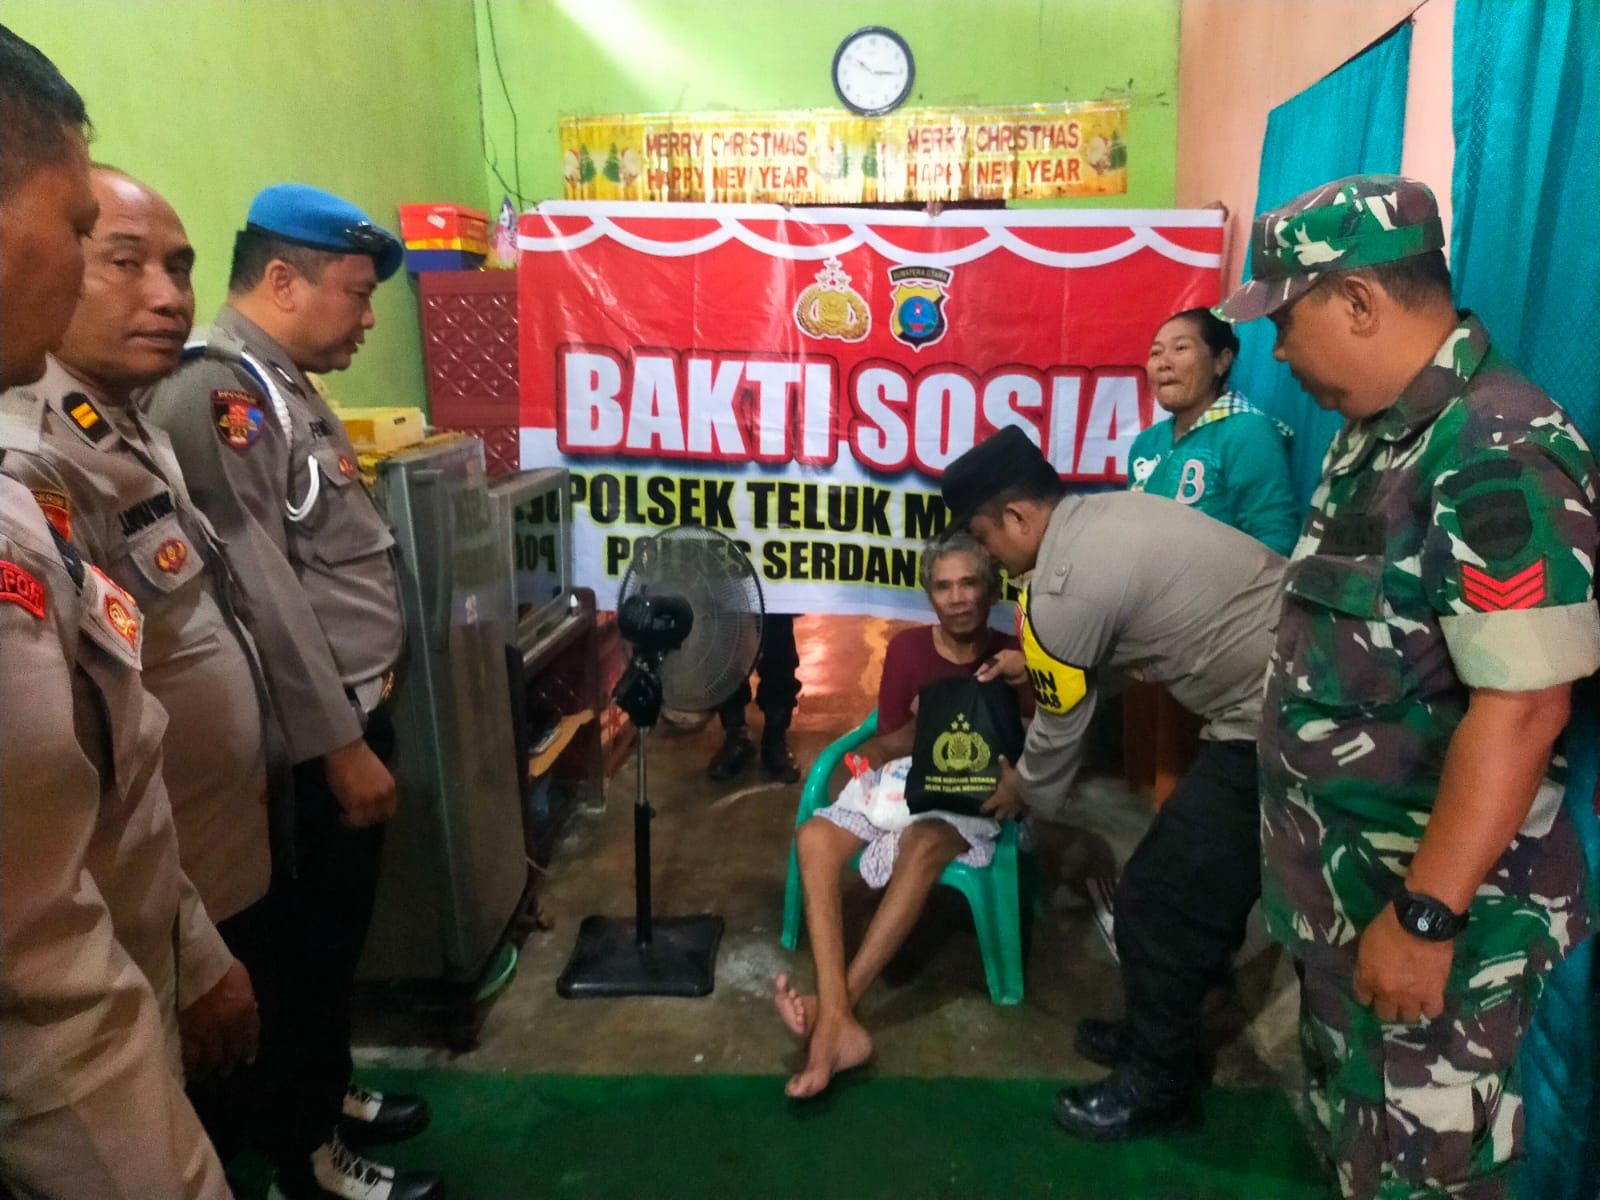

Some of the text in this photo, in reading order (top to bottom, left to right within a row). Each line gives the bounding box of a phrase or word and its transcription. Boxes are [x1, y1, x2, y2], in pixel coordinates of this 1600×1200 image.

[646, 130, 808, 158] MERRY CHRISTMAS
[907, 121, 1080, 154] MERRY CHRISTMAS
[646, 164, 809, 191] HAPPY NEW YEAR
[906, 157, 1082, 187] HAPPY NEW YEAR
[564, 351, 832, 458] BAKTI
[570, 473, 736, 529] POLSEK
[746, 481, 891, 538] TELUK
[763, 540, 918, 588] SERDAN
